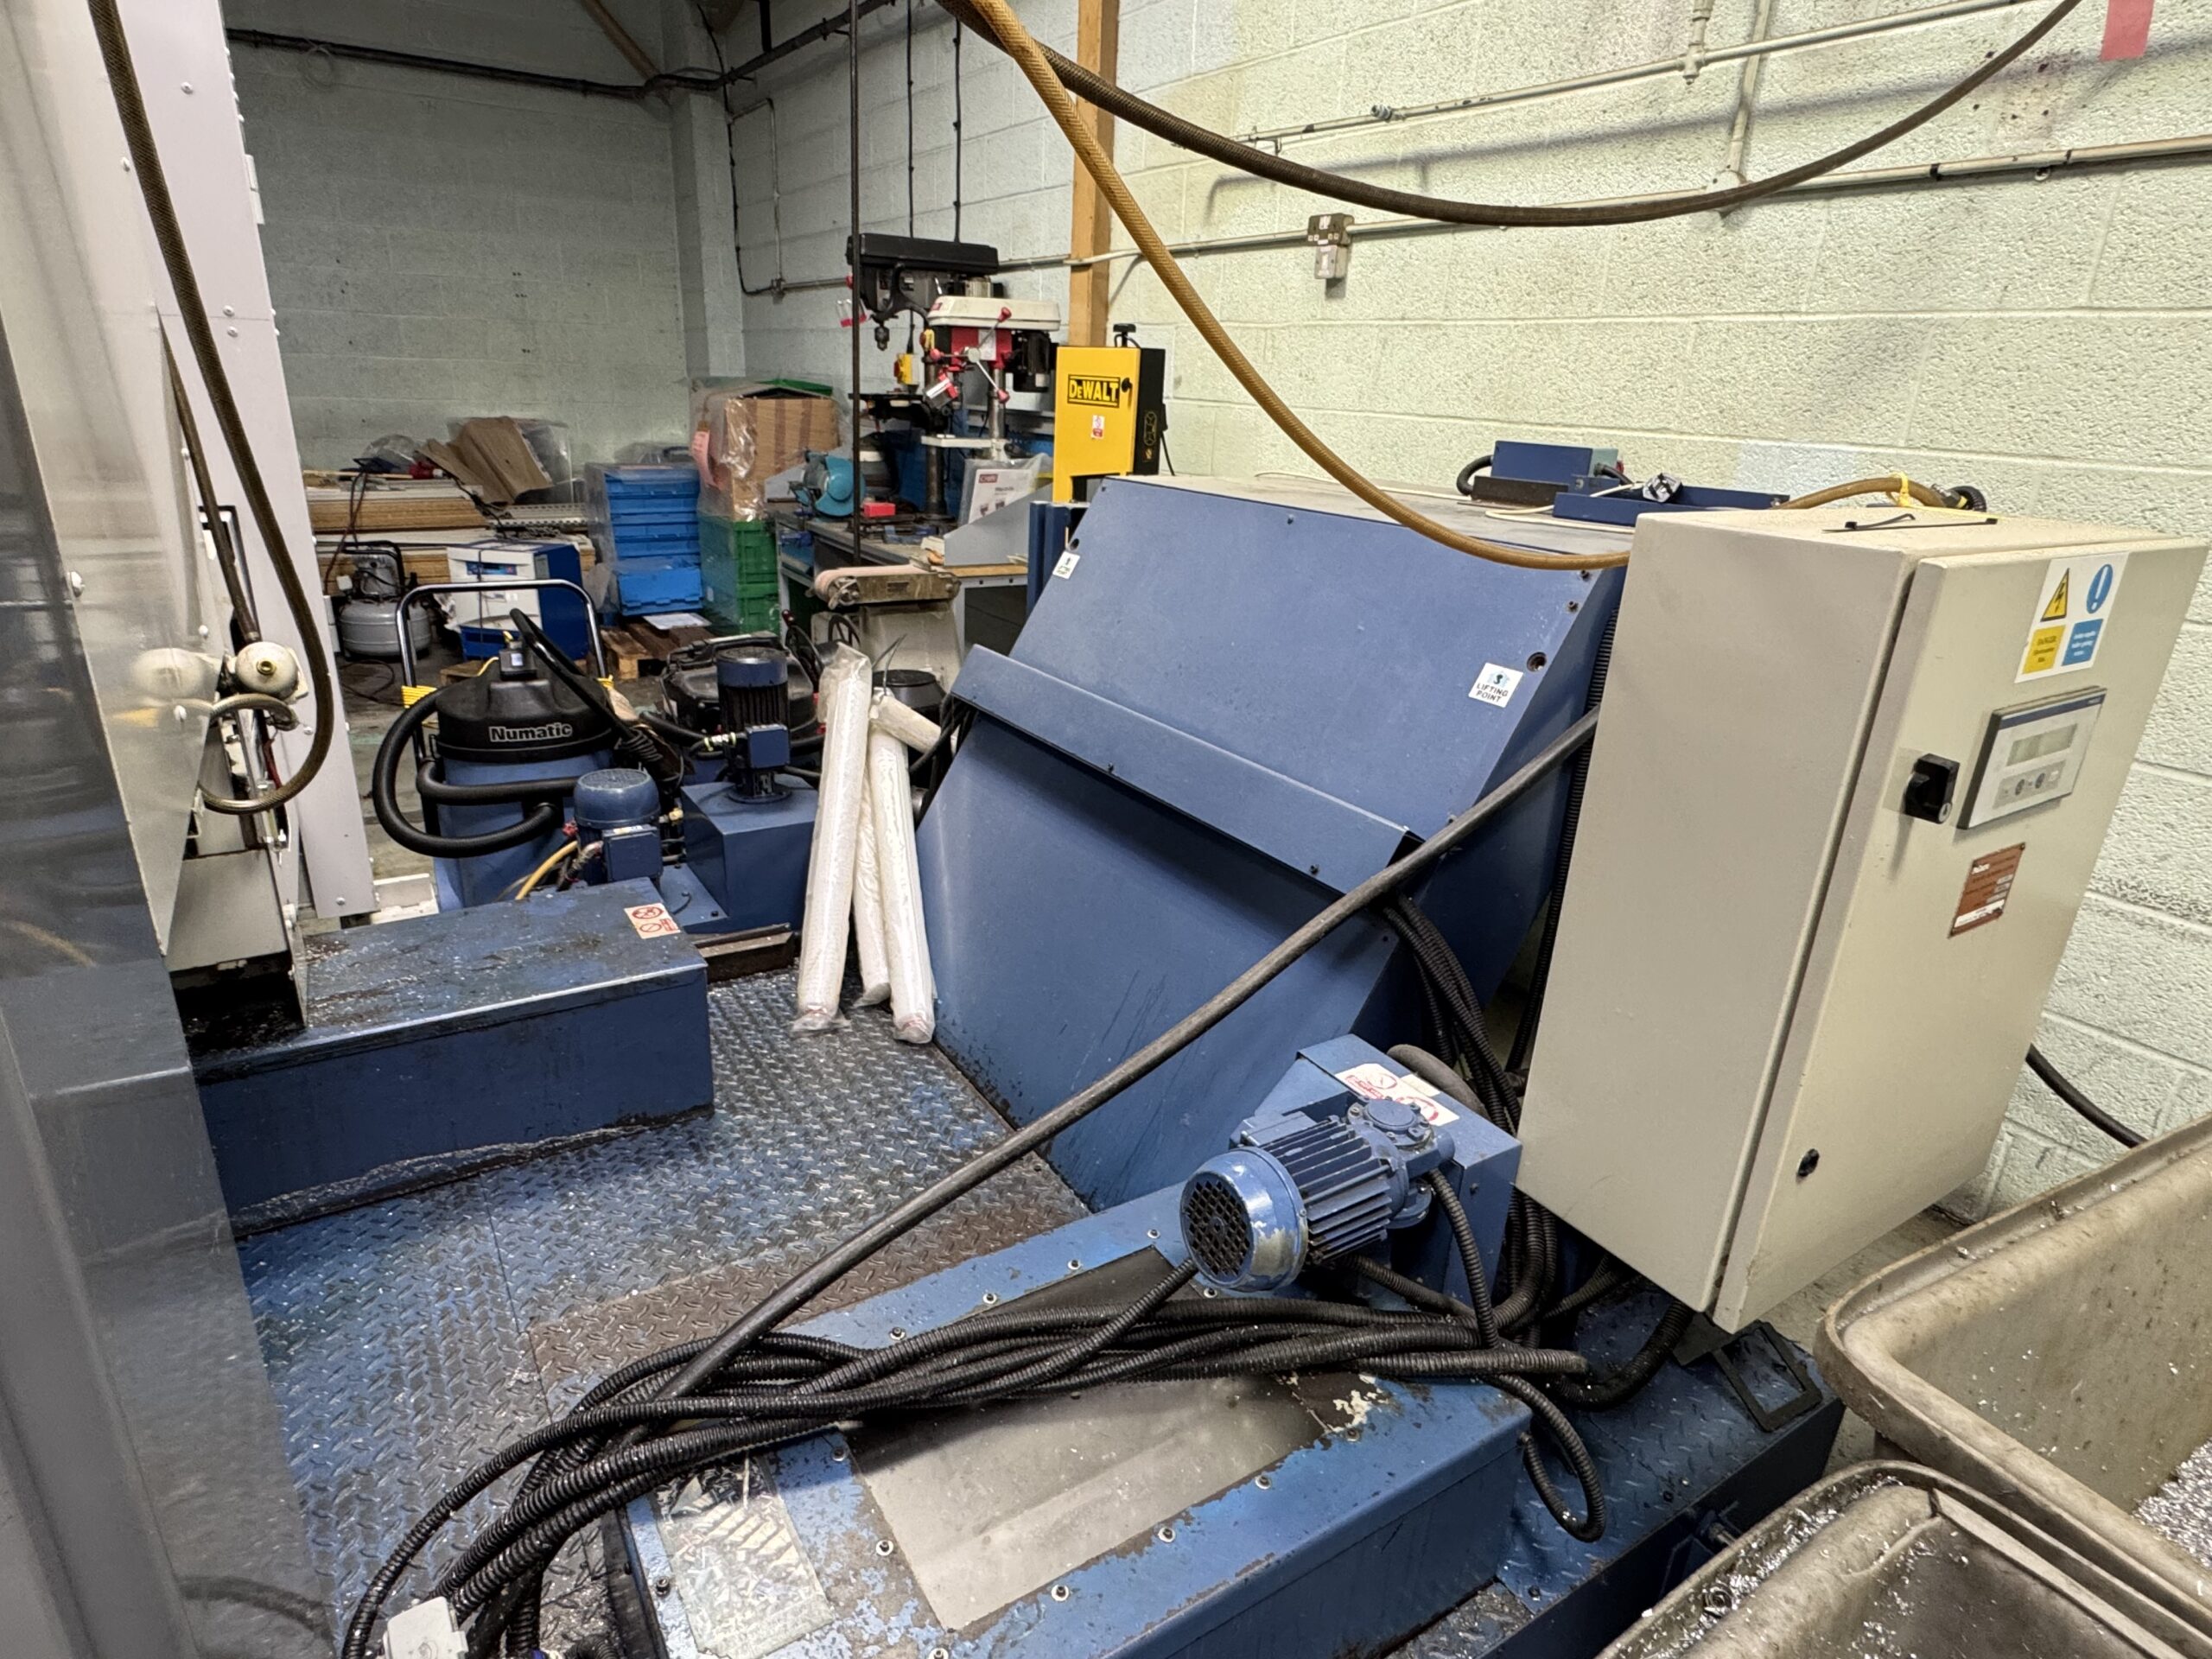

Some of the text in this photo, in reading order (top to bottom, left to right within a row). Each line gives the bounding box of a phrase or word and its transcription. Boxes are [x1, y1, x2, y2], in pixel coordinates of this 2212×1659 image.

[1476, 683, 1509, 697] LIFTING
[1476, 690, 1503, 702] POINT
[488, 722, 573, 742] Numatic
